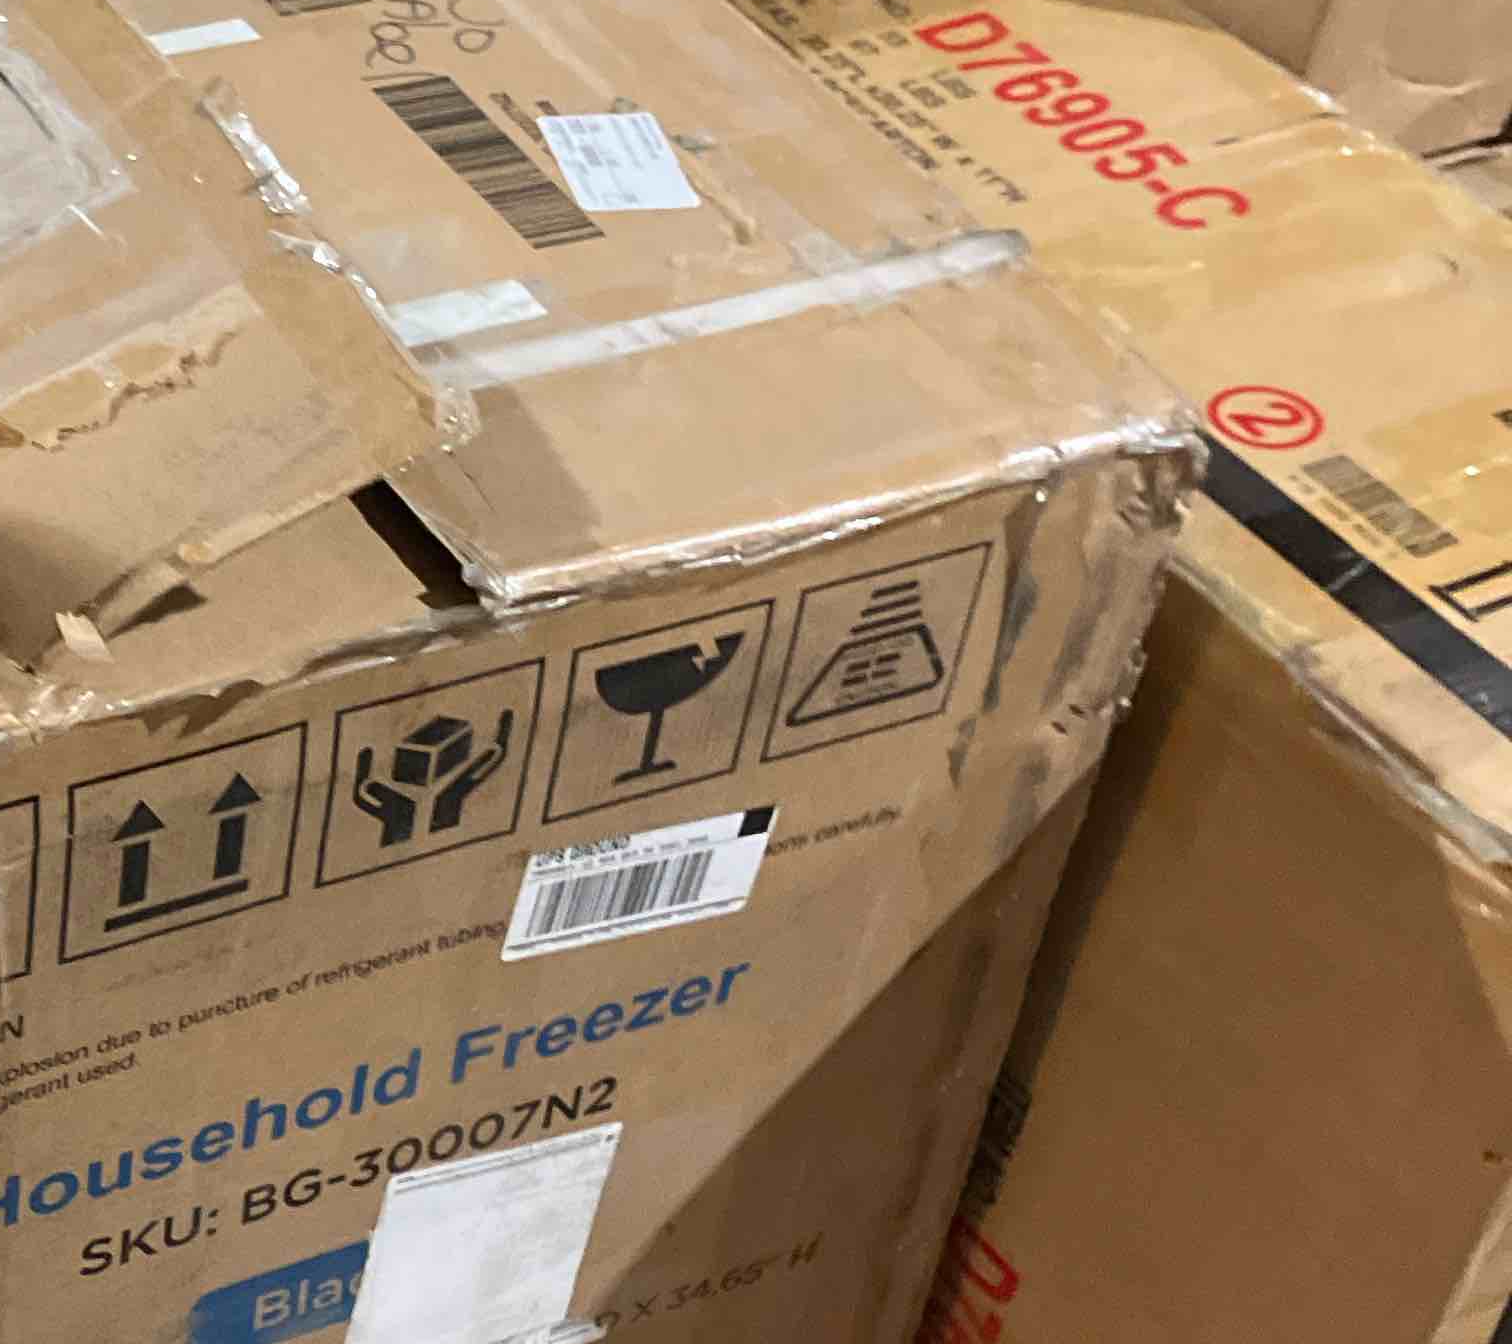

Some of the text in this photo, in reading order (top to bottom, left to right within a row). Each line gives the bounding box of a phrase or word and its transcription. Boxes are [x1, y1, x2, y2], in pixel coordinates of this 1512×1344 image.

[913, 9, 1252, 231] D76905-C
[98, 1027, 142, 1057] due
[149, 1014, 172, 1039] to
[178, 989, 281, 1037] puncture
[450, 963, 751, 1085] Freezer
[78, 1075, 618, 1277] SKU: BG-30007N2
